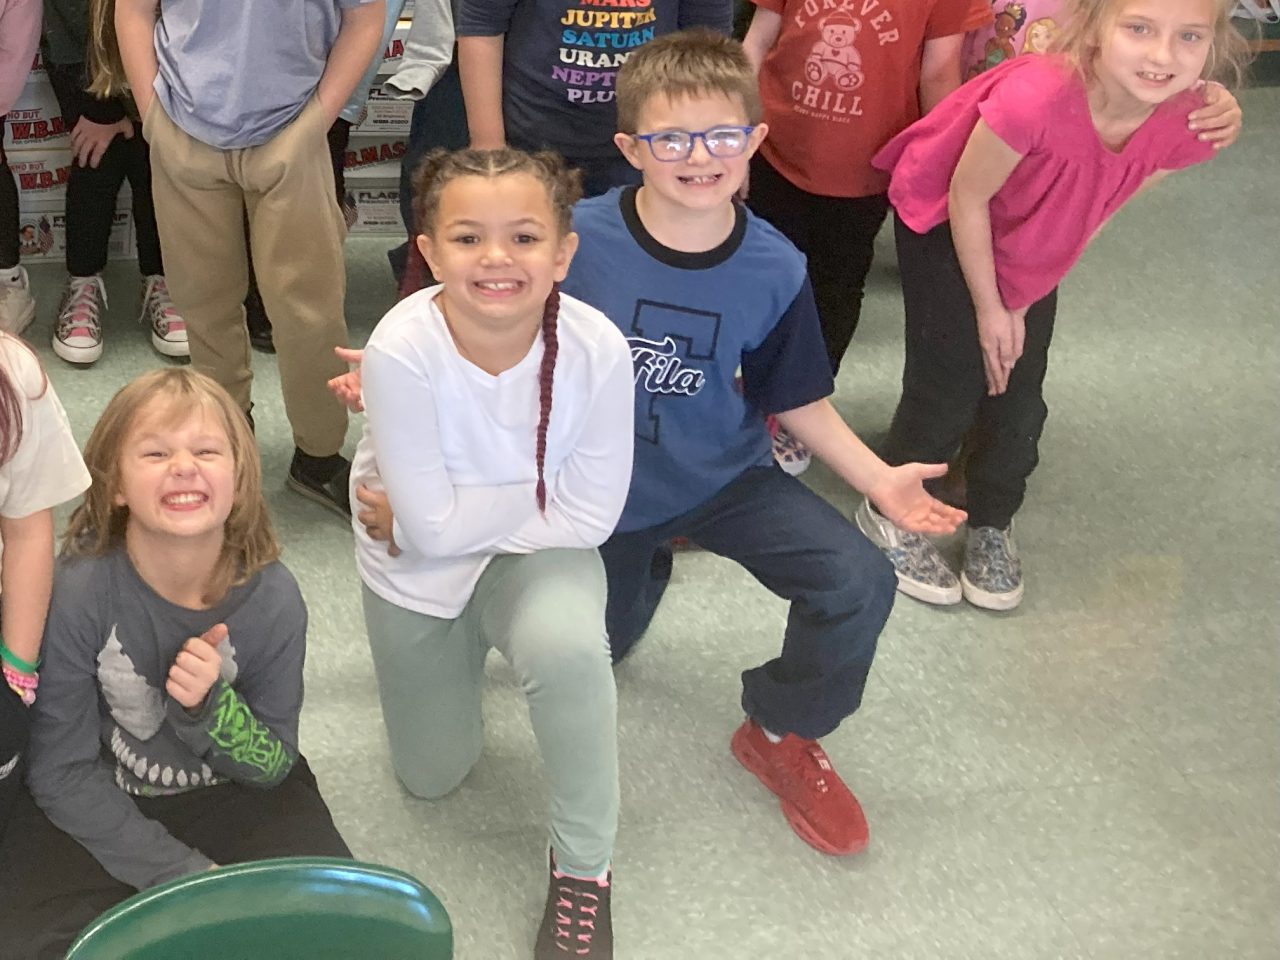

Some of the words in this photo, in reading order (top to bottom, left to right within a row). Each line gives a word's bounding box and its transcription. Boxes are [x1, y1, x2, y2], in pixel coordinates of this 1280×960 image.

[560, 7, 657, 29] JUPITER
[562, 26, 655, 48] SATURN
[559, 48, 635, 68] URAN
[552, 65, 617, 86] NEPT
[567, 88, 617, 104] PLU
[792, 80, 863, 116] CHILL
[22, 111, 40, 119] BUT
[29, 162, 45, 171] BUT
[624, 336, 706, 396] Fila
